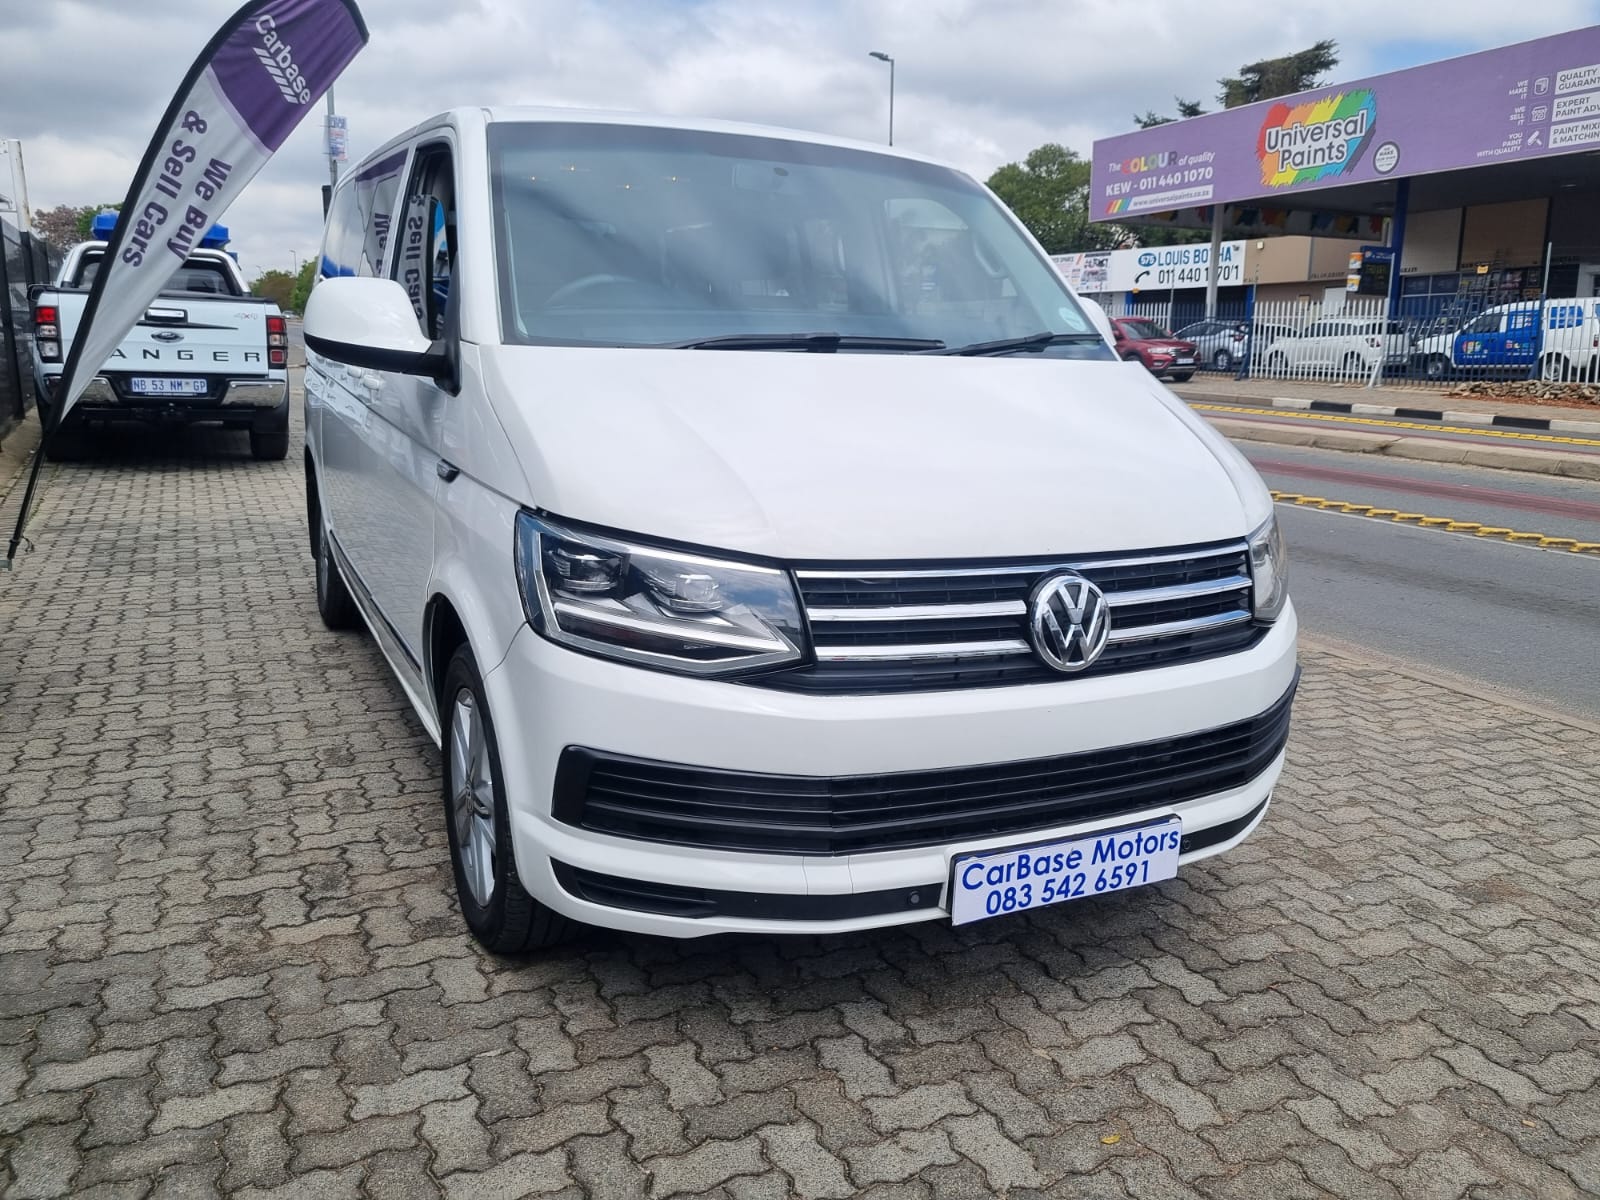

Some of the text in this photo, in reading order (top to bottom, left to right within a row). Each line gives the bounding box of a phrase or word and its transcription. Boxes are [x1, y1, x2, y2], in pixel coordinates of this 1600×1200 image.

[256, 15, 310, 104] Carbase
[1559, 68, 1598, 82] QUALITY
[1555, 108, 1582, 118] PAINT
[1556, 97, 1591, 109] EXPERT
[1267, 112, 1365, 150] Universal
[1509, 132, 1523, 140] YOU
[1553, 126, 1579, 136] PAINT
[1108, 151, 1216, 174] The COLOUR of quality
[1279, 141, 1346, 170] Paints
[122, 110, 207, 267] & Sell Cars
[1105, 180, 1132, 197] KEW
[1140, 176, 1158, 190] 011
[1158, 172, 1182, 187] 440
[1183, 166, 1214, 183] 1070
[166, 158, 232, 261] We Buy
[1157, 250, 1190, 266] LOUIS
[1193, 246, 1232, 264] BOHA
[1158, 267, 1175, 284] 011
[1178, 267, 1201, 282] 440
[110, 349, 260, 362] ANGER
[133, 380, 206, 391] NB 53 NM GP
[962, 830, 1179, 890] CarBase Motors
[986, 860, 1149, 915] 083 542 6591
